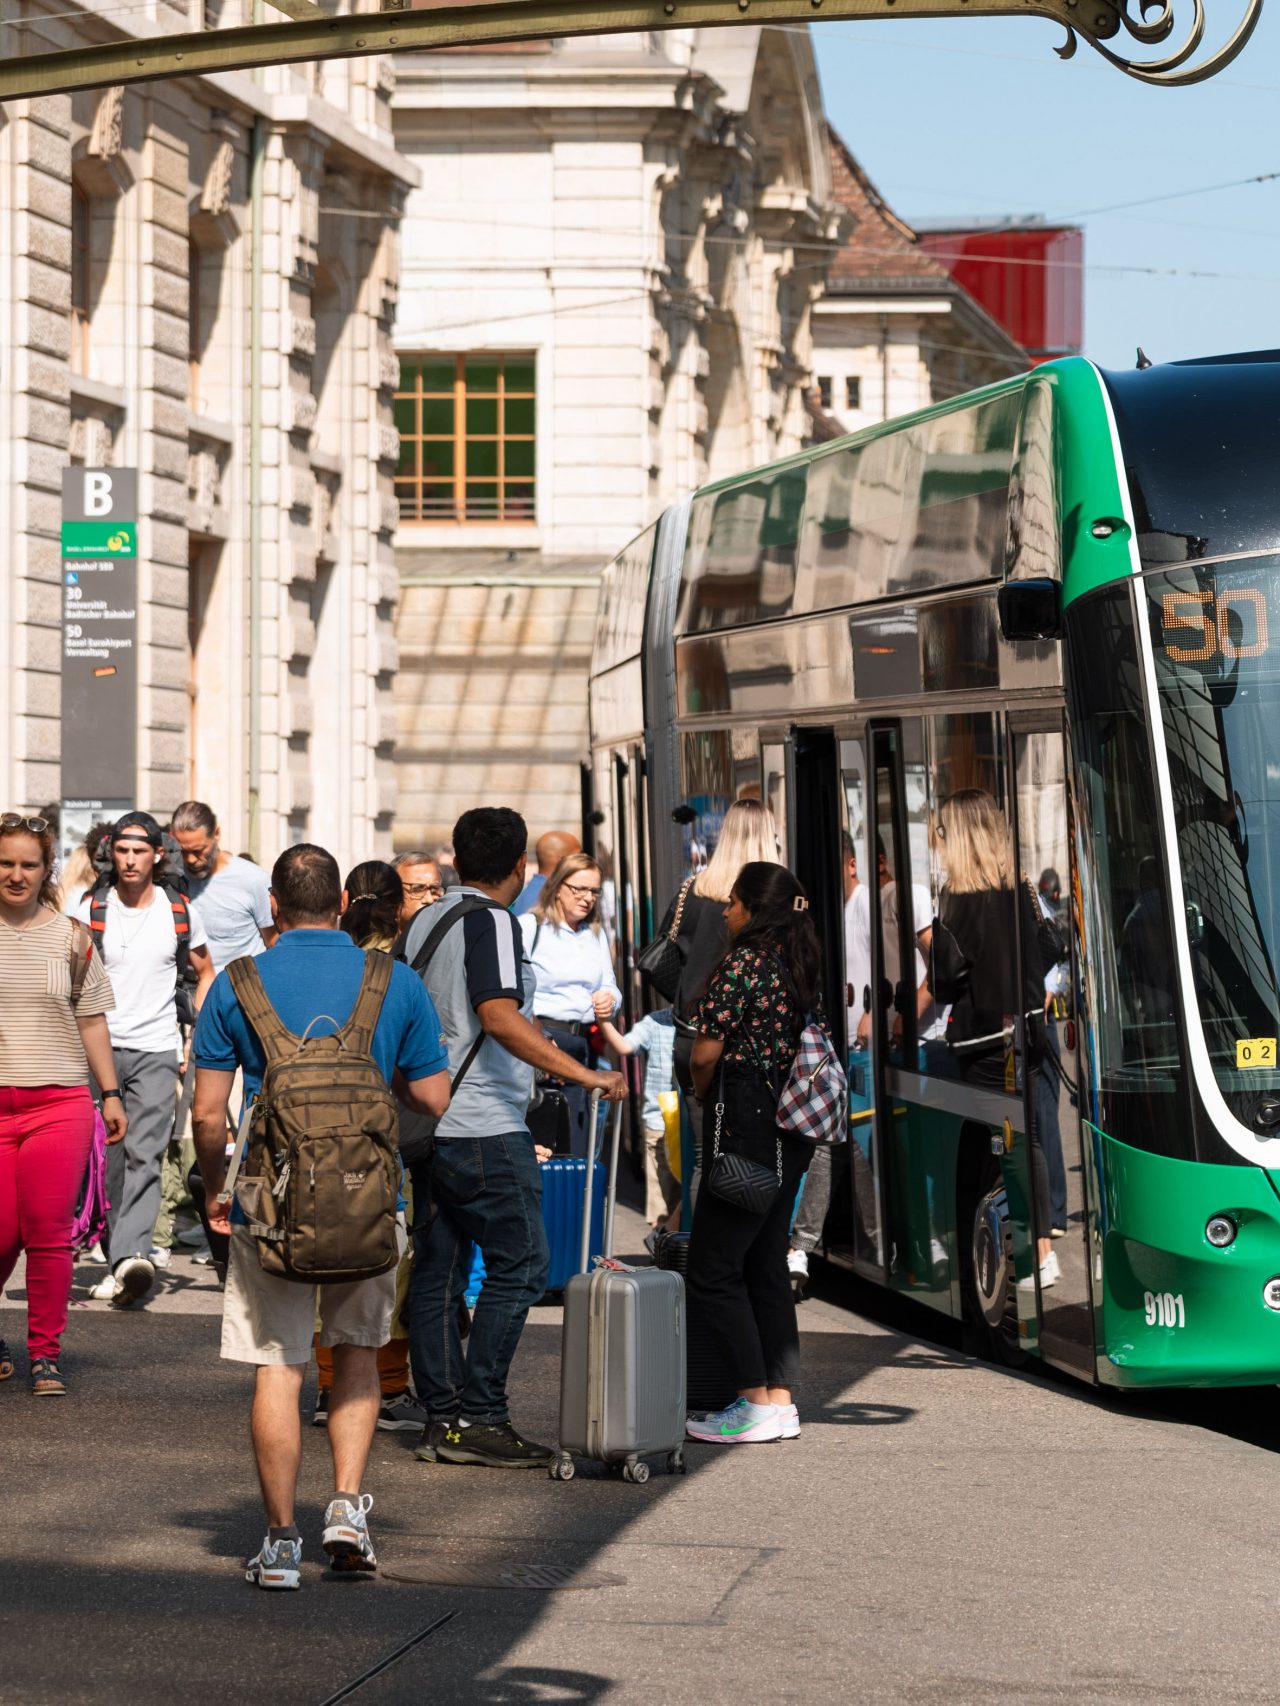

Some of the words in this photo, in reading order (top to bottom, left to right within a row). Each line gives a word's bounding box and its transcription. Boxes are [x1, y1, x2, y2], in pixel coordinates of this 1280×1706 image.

[84, 472, 113, 516] B
[65, 562, 98, 571] Bahnhof
[65, 587, 82, 600] 30
[65, 610, 102, 619] Badischer
[103, 610, 135, 619] Bahnhof
[65, 624, 82, 638] 50
[1162, 588, 1268, 661] 50
[65, 638, 87, 647] Basel
[65, 648, 109, 658] Verwaltung
[1144, 1291, 1185, 1328] 9101
